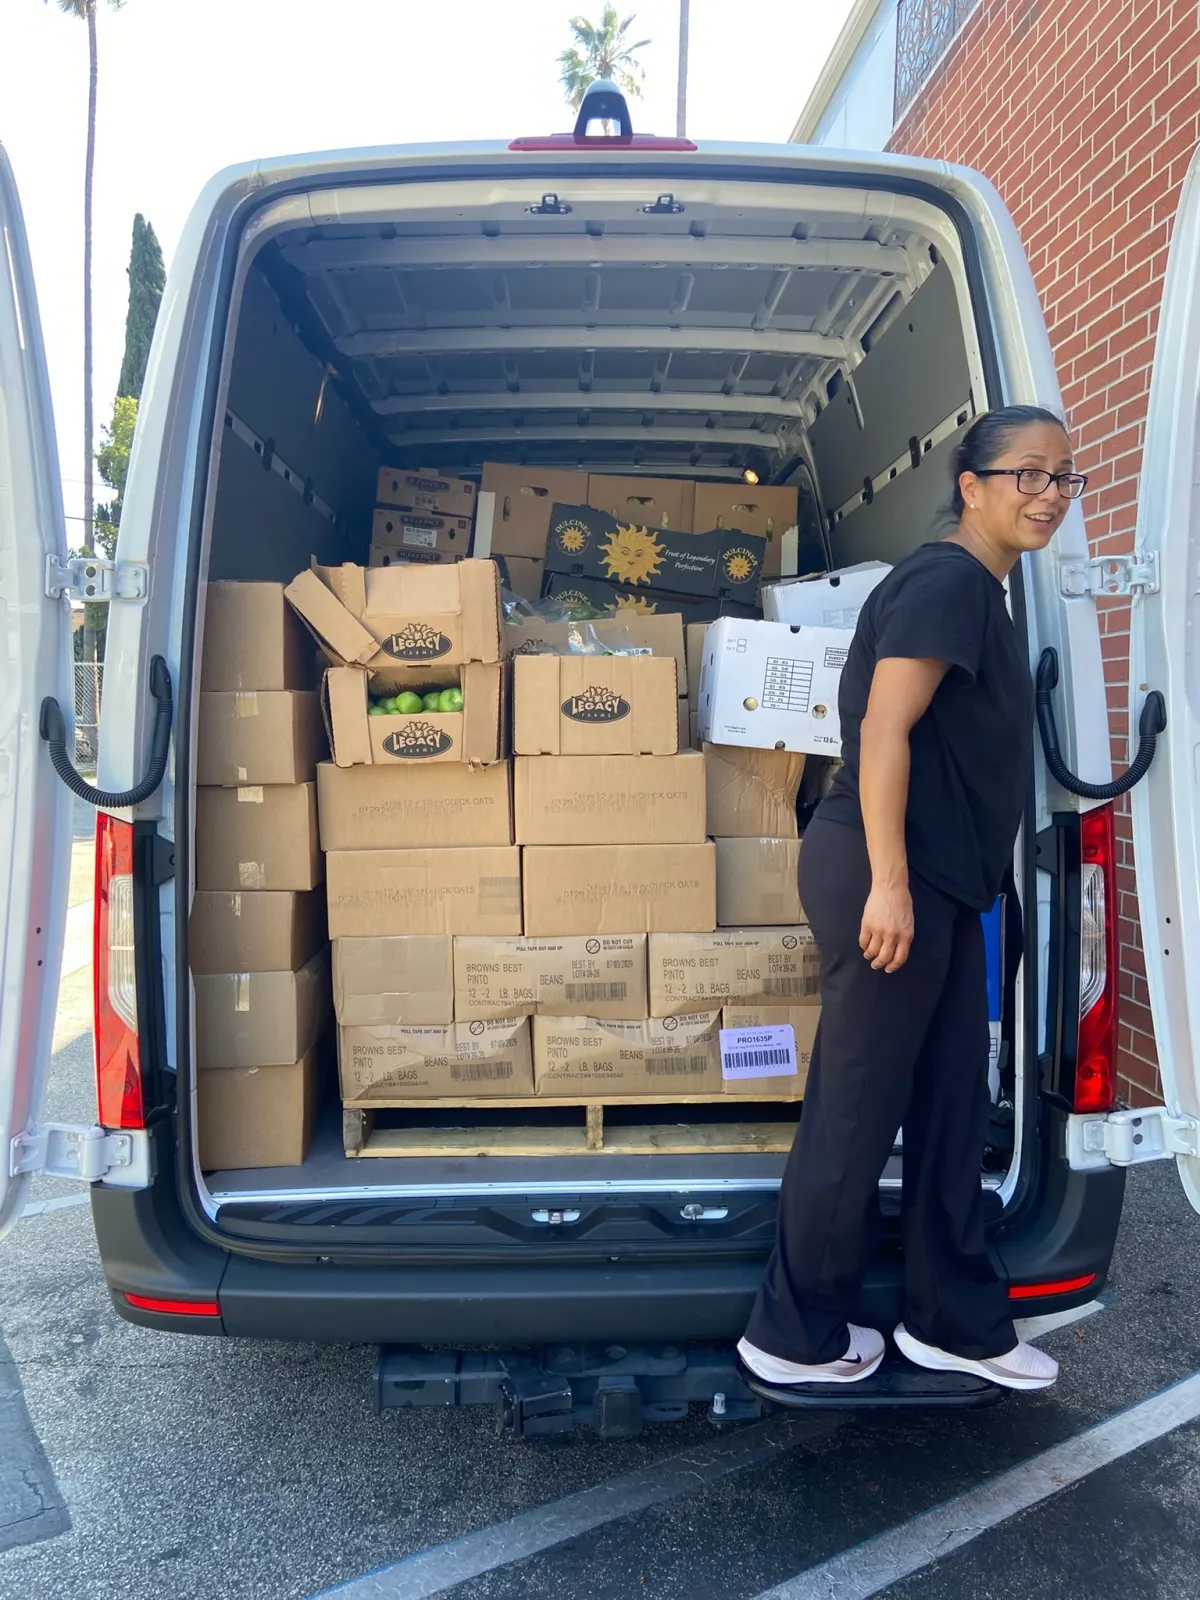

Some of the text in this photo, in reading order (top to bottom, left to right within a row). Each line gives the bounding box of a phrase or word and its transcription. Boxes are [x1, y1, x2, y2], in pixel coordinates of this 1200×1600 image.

[555, 520, 592, 537] DULCINEA
[723, 547, 758, 566] DULCINEA
[391, 632, 442, 653] LEGACY
[572, 696, 621, 715] LEGACY
[392, 729, 443, 751] LEGACY
[666, 791, 688, 800] OATS
[445, 798, 471, 806] QUICK
[473, 797, 495, 805] OATS
[454, 886, 475, 895] OATS
[677, 881, 699, 889] OATS
[571, 959, 585, 969] BEST
[588, 959, 596, 969] BY
[662, 958, 719, 968] BROWNS BEST
[768, 954, 782, 964] BEST
[784, 954, 792, 963] BY
[466, 963, 522, 973] BROWNS BEST
[467, 974, 564, 986] PINTO BEANS
[663, 969, 761, 980] PINTO BEANS
[468, 988, 476, 999] 12
[514, 988, 533, 999] BAGS
[664, 983, 673, 994] 12
[710, 983, 730, 994] BAGS
[546, 1036, 603, 1047] BROWNS BEST
[651, 1036, 665, 1046] BEST
[667, 1035, 675, 1045] BY
[737, 1035, 773, 1044] PRO1635P
[352, 1045, 407, 1055] BROWNS BEST
[456, 1042, 470, 1052] BEST
[472, 1041, 479, 1051] BY
[547, 1048, 644, 1060] PINTO BEANS
[353, 1057, 448, 1068] PINTO BEANS
[547, 1061, 556, 1071] 12
[593, 1062, 613, 1072] BAGS
[354, 1071, 361, 1082] 12
[398, 1070, 418, 1081] BAGS
